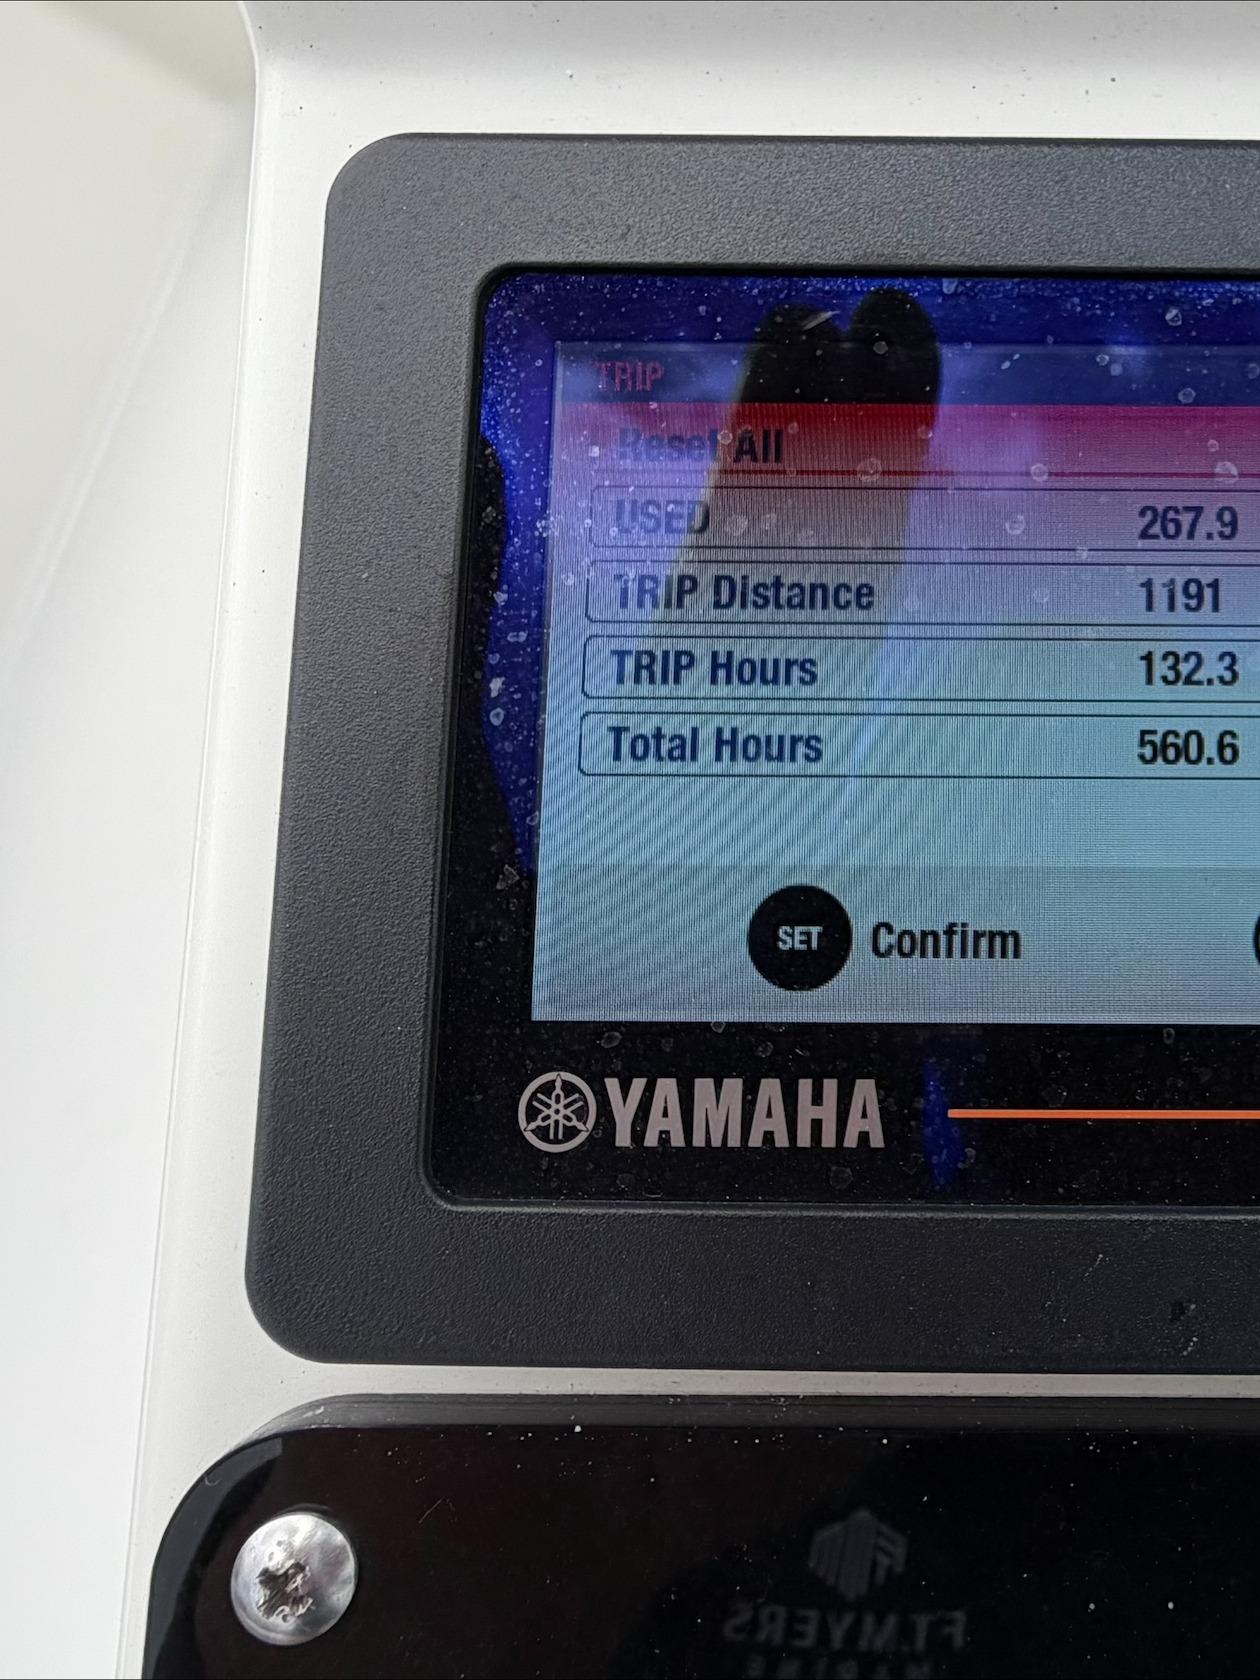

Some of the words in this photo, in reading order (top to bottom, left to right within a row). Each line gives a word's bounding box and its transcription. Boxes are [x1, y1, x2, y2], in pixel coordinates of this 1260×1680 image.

[596, 361, 664, 391] TRIP
[618, 428, 720, 462] Reset
[733, 428, 784, 463] All
[615, 500, 710, 534] USED
[1137, 506, 1240, 541] 267.9
[614, 574, 698, 609] TRIP
[713, 575, 875, 611] Distance
[1139, 577, 1223, 613] 1191
[611, 650, 695, 686] TRIP
[709, 651, 818, 687] Hours
[1139, 651, 1240, 687] 132.3
[607, 726, 698, 762] Total
[714, 727, 823, 763] Hours
[1137, 729, 1240, 765] 560.6
[776, 926, 823, 951] SET
[871, 922, 1022, 960] Confirm
[604, 1077, 886, 1148] YAMAHA
